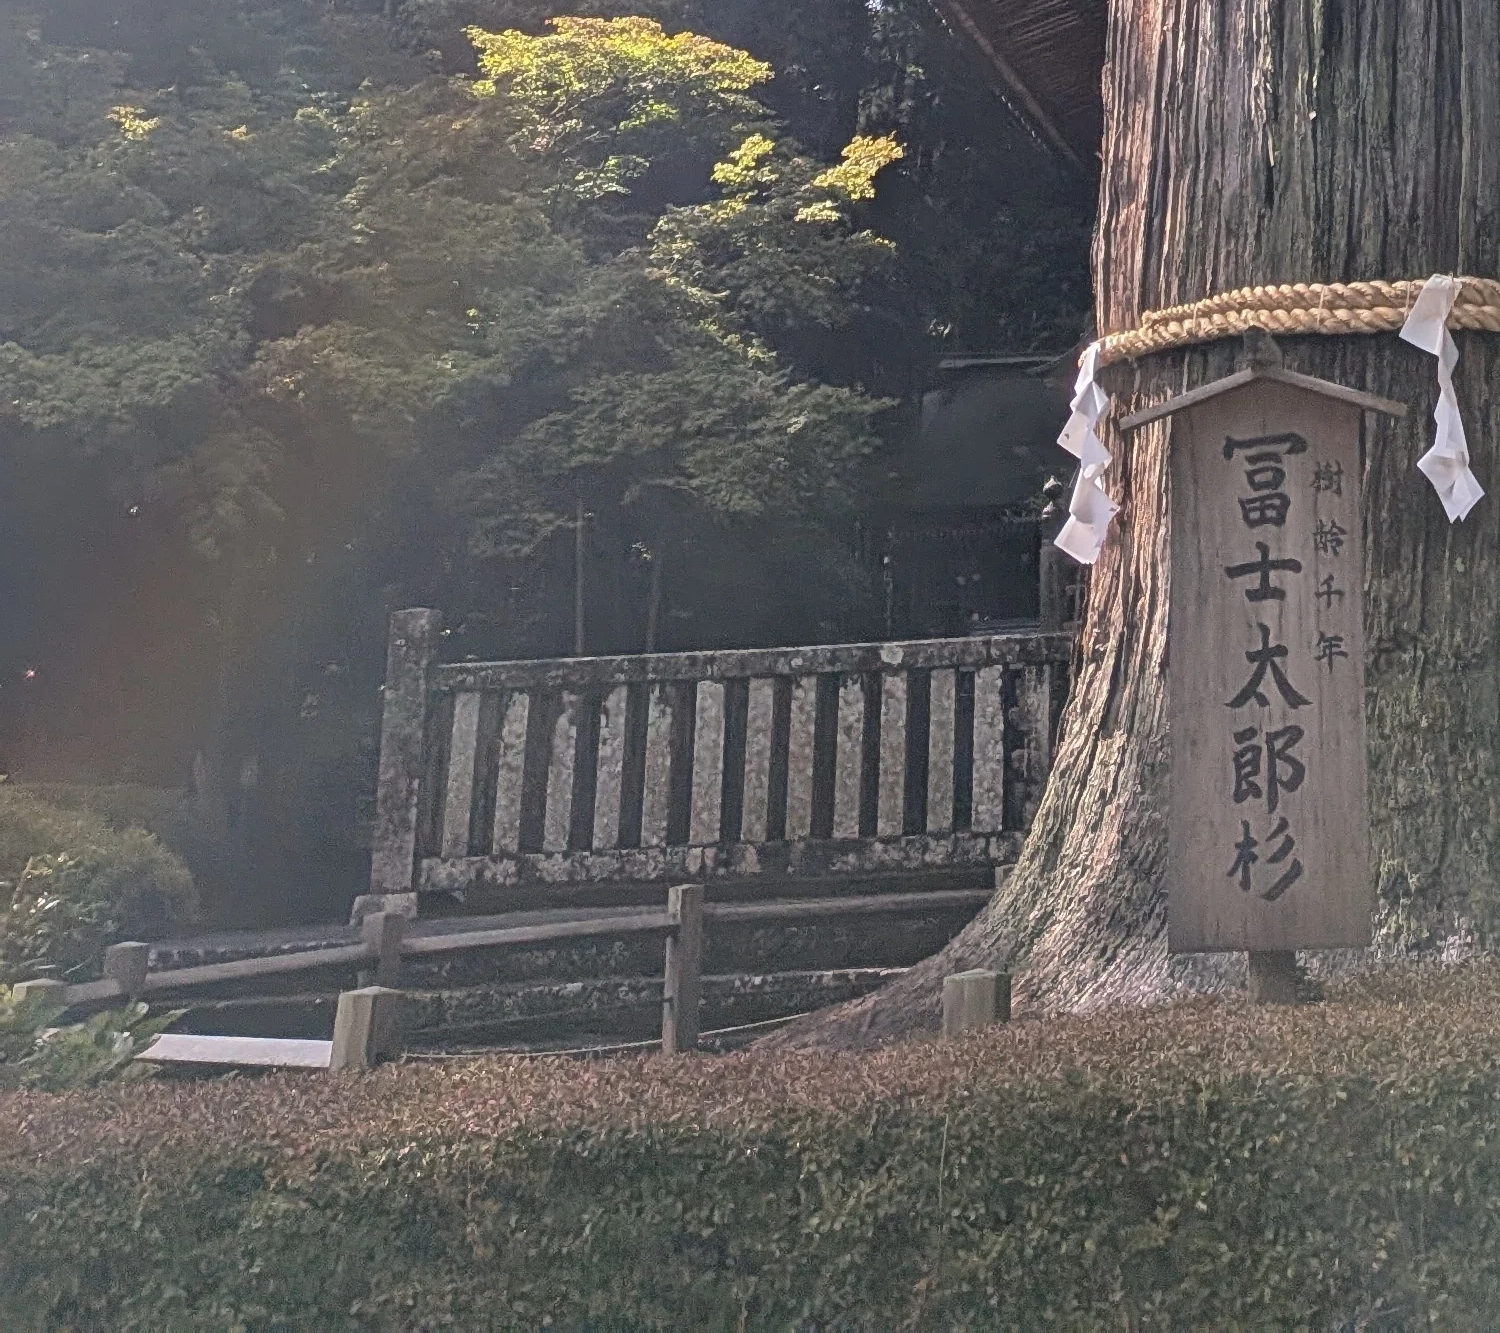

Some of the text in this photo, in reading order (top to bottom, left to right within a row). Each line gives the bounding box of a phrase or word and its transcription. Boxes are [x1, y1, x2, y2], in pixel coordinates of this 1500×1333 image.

[1223, 432, 1313, 902] 冨士太郎杉
[1311, 460, 1348, 673] 樹齢千年
